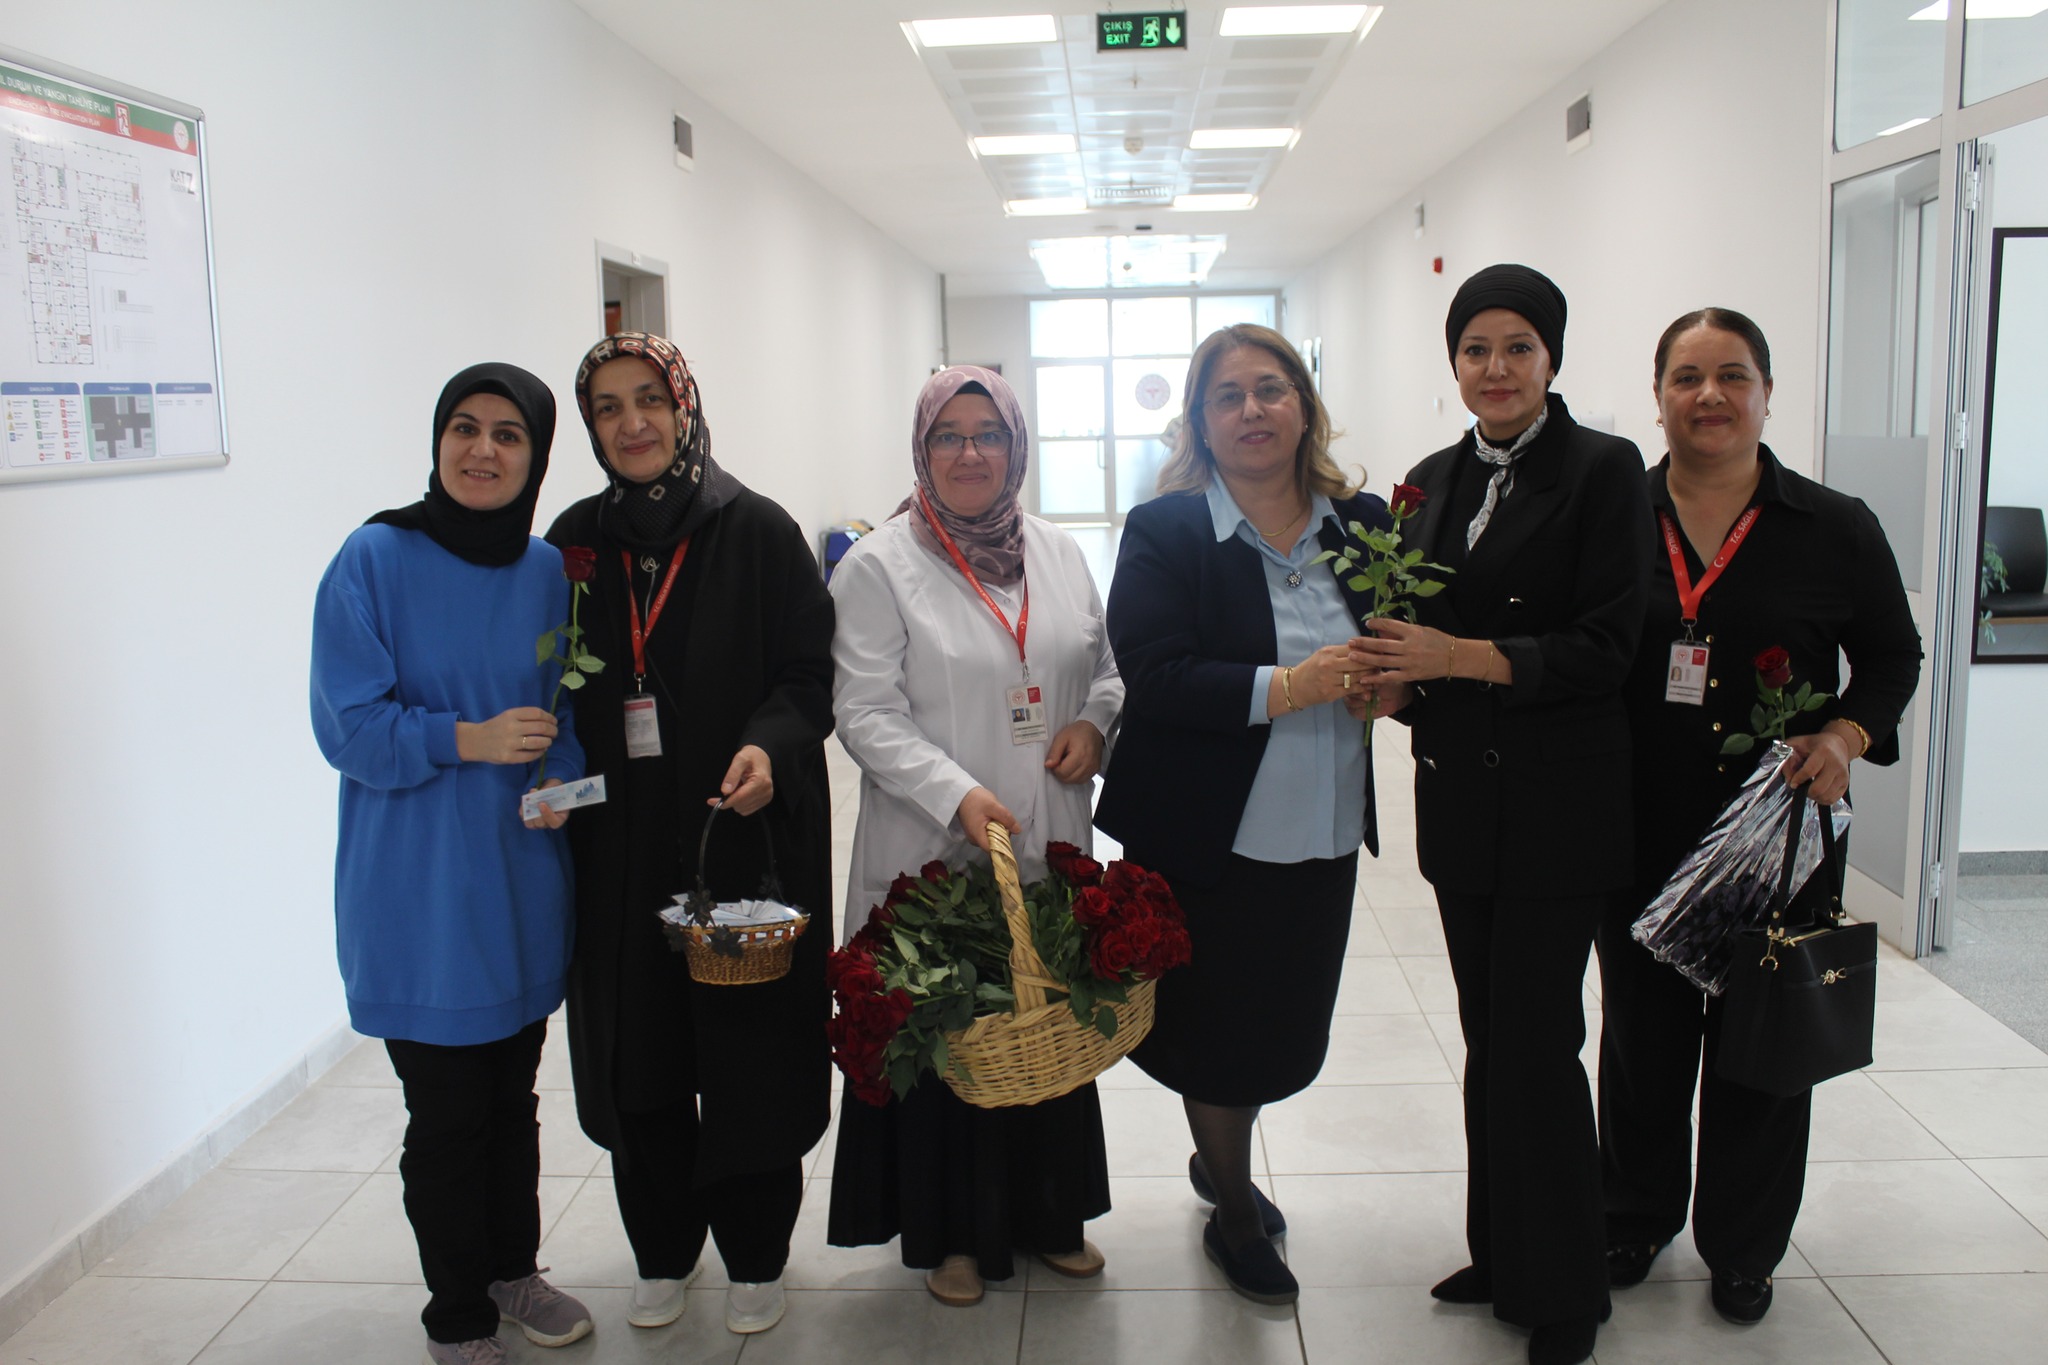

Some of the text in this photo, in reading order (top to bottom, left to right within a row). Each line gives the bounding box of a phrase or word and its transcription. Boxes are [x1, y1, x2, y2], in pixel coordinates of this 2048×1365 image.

[1103, 21, 1133, 33] ÇIKIŞ
[1106, 34, 1130, 45] EXIT
[31, 83, 42, 96] VE
[1730, 532, 1742, 544] T.C.
